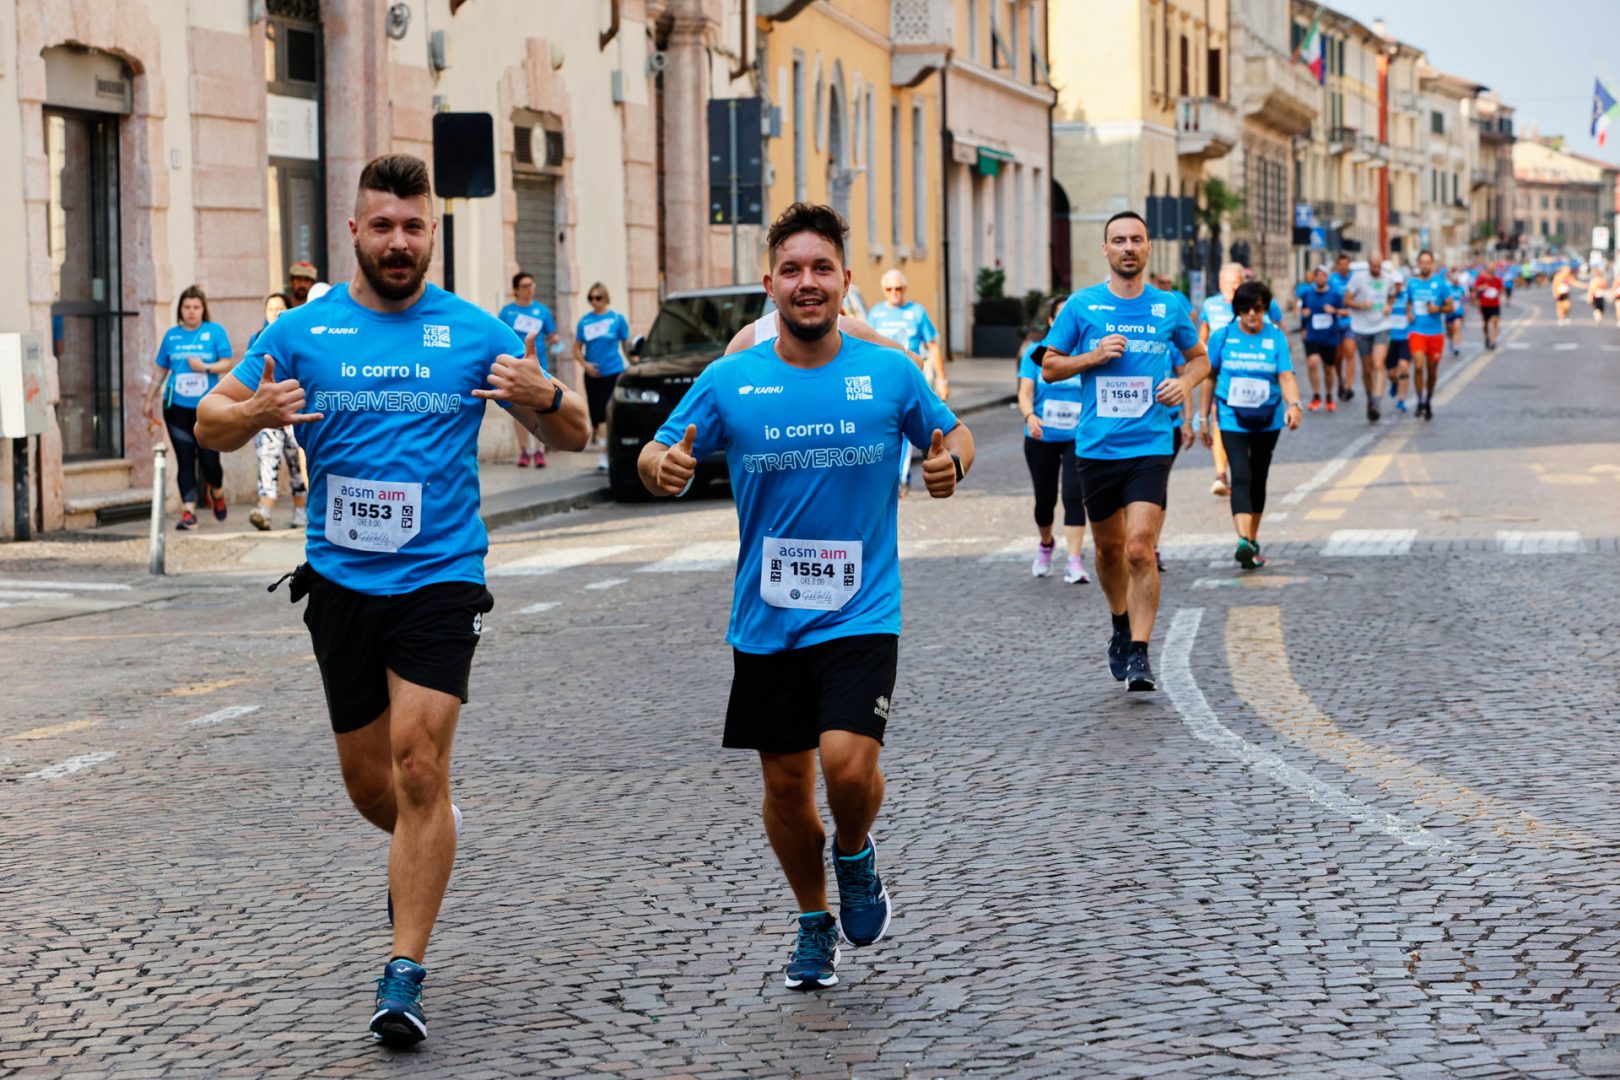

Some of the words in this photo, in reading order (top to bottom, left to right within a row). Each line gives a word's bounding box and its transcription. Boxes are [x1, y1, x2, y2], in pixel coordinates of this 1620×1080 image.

[1117, 324, 1145, 333] corro
[1146, 323, 1156, 334] la
[341, 362, 357, 377] io
[362, 364, 410, 378] corro
[415, 363, 430, 379] la
[754, 385, 783, 395] KARHU
[1111, 390, 1138, 399] 1564
[314, 390, 462, 413] STRAVERONA
[764, 424, 780, 440] io
[786, 422, 835, 438] corro
[840, 419, 856, 434] la
[743, 442, 885, 473] STRAVERONA
[349, 501, 392, 520] 1553
[790, 561, 835, 578] 1554
